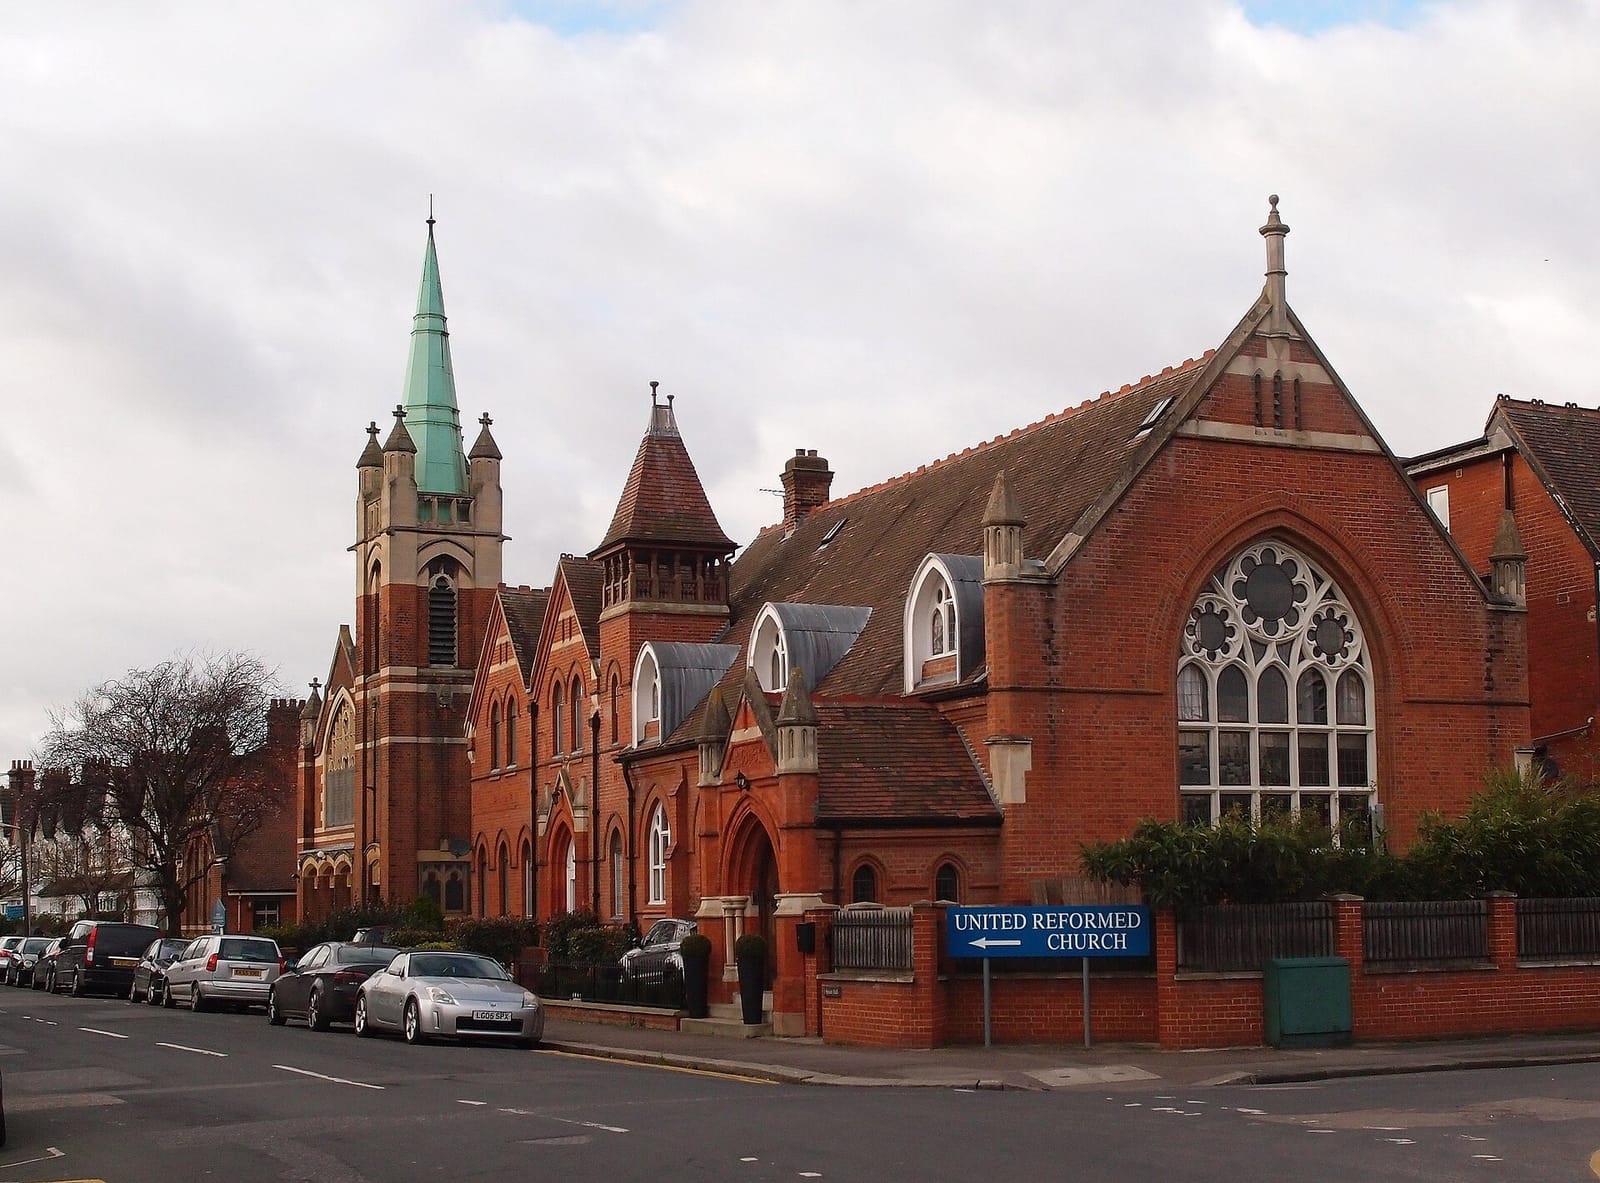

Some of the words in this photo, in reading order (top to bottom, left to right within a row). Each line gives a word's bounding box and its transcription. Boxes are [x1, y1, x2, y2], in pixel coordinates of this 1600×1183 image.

[955, 914, 1027, 931] UNITED
[1032, 912, 1141, 930] REFORMED
[1047, 933, 1127, 951] CHURCH
